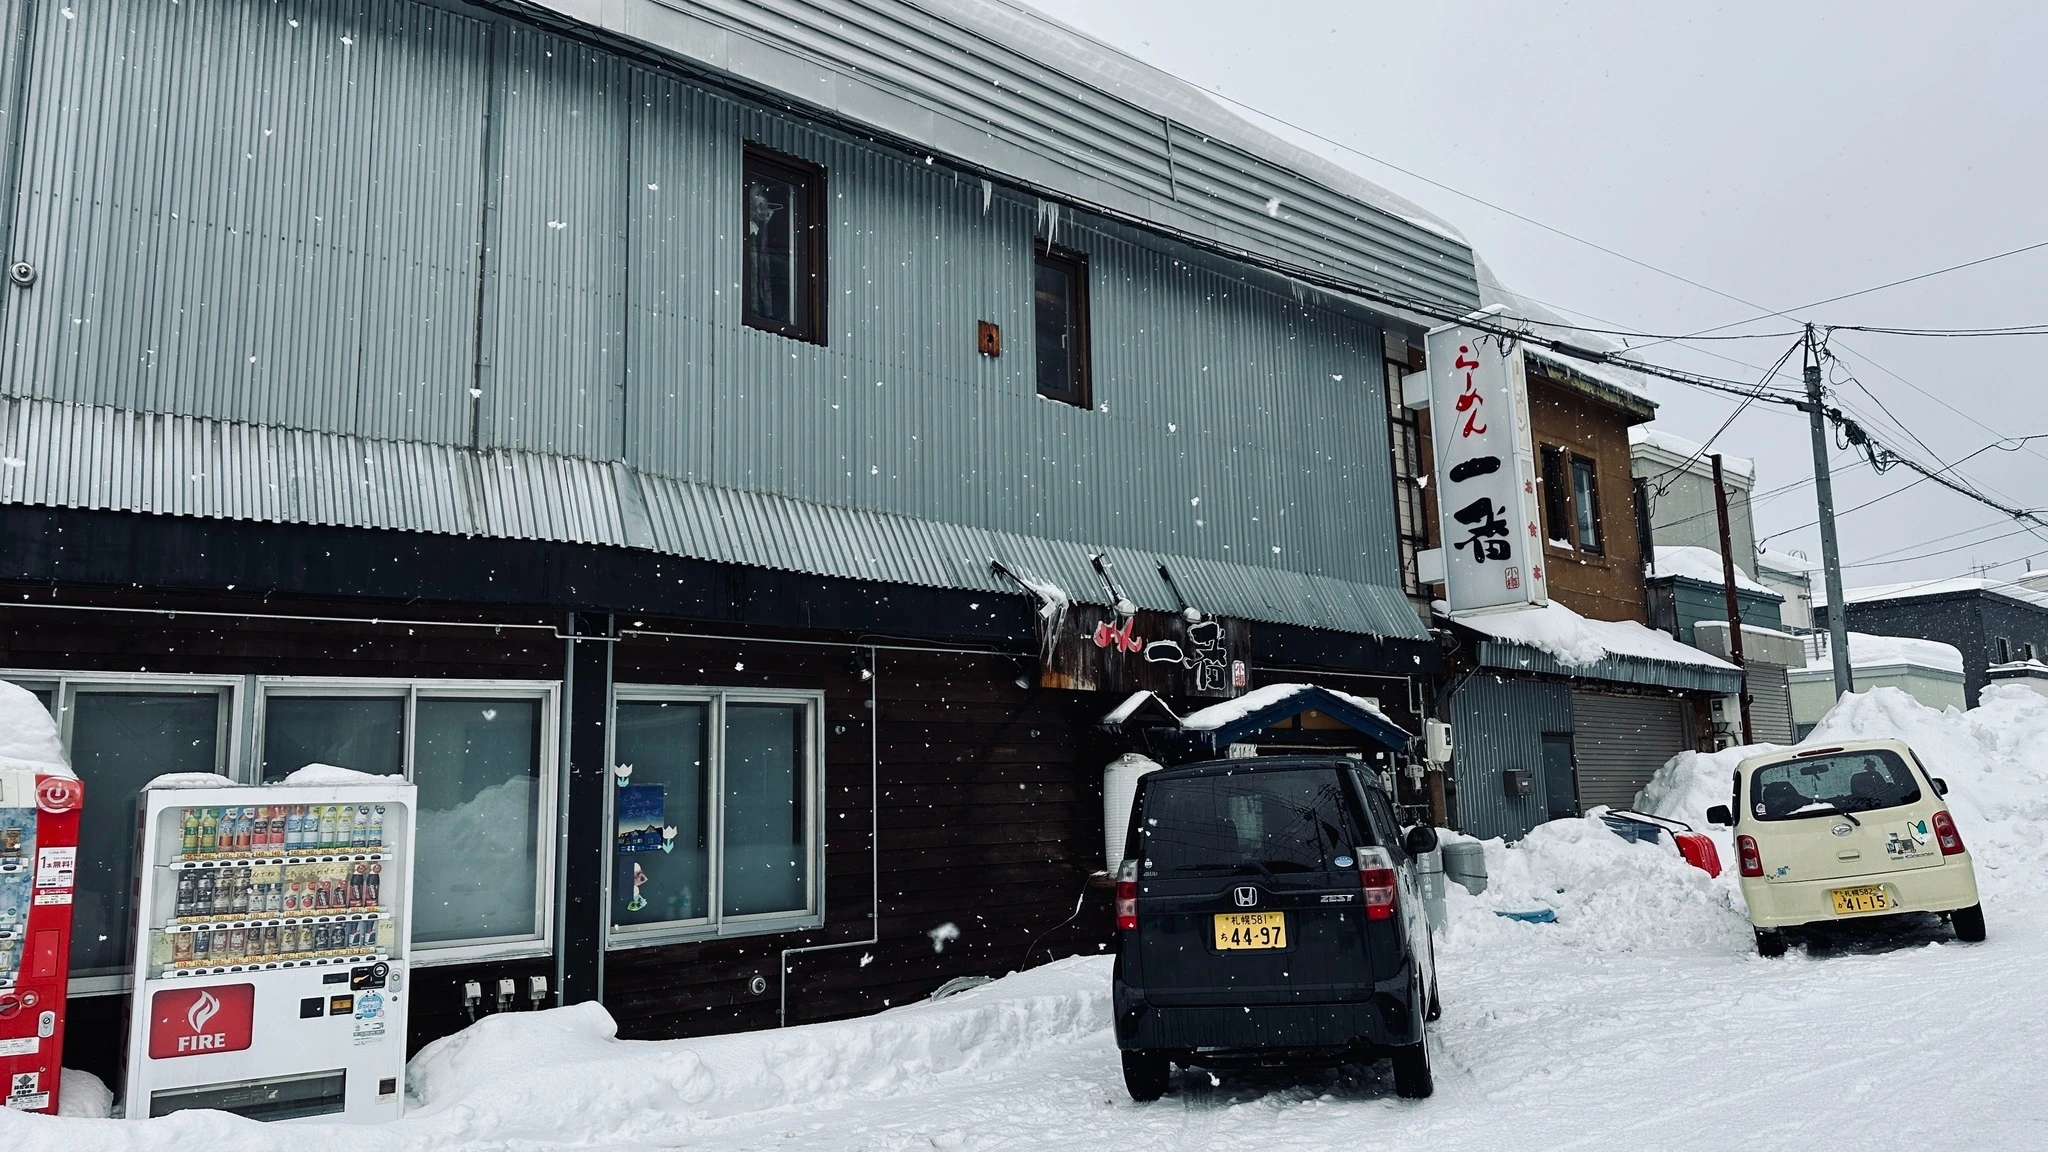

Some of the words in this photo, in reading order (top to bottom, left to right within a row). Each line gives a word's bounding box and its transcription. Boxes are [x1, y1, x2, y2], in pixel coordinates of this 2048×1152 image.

[1455, 345, 1487, 438] らーめん
[1449, 455, 1511, 563] 一番
[1524, 479, 1542, 580] お食事
[1320, 894, 1354, 903] ZEST
[1846, 895, 1886, 911] 41-15
[1231, 914, 1267, 925] 札幌581
[1221, 933, 1228, 942] ち
[1231, 926, 1281, 946] 44-97
[177, 1033, 226, 1052] FIRE
